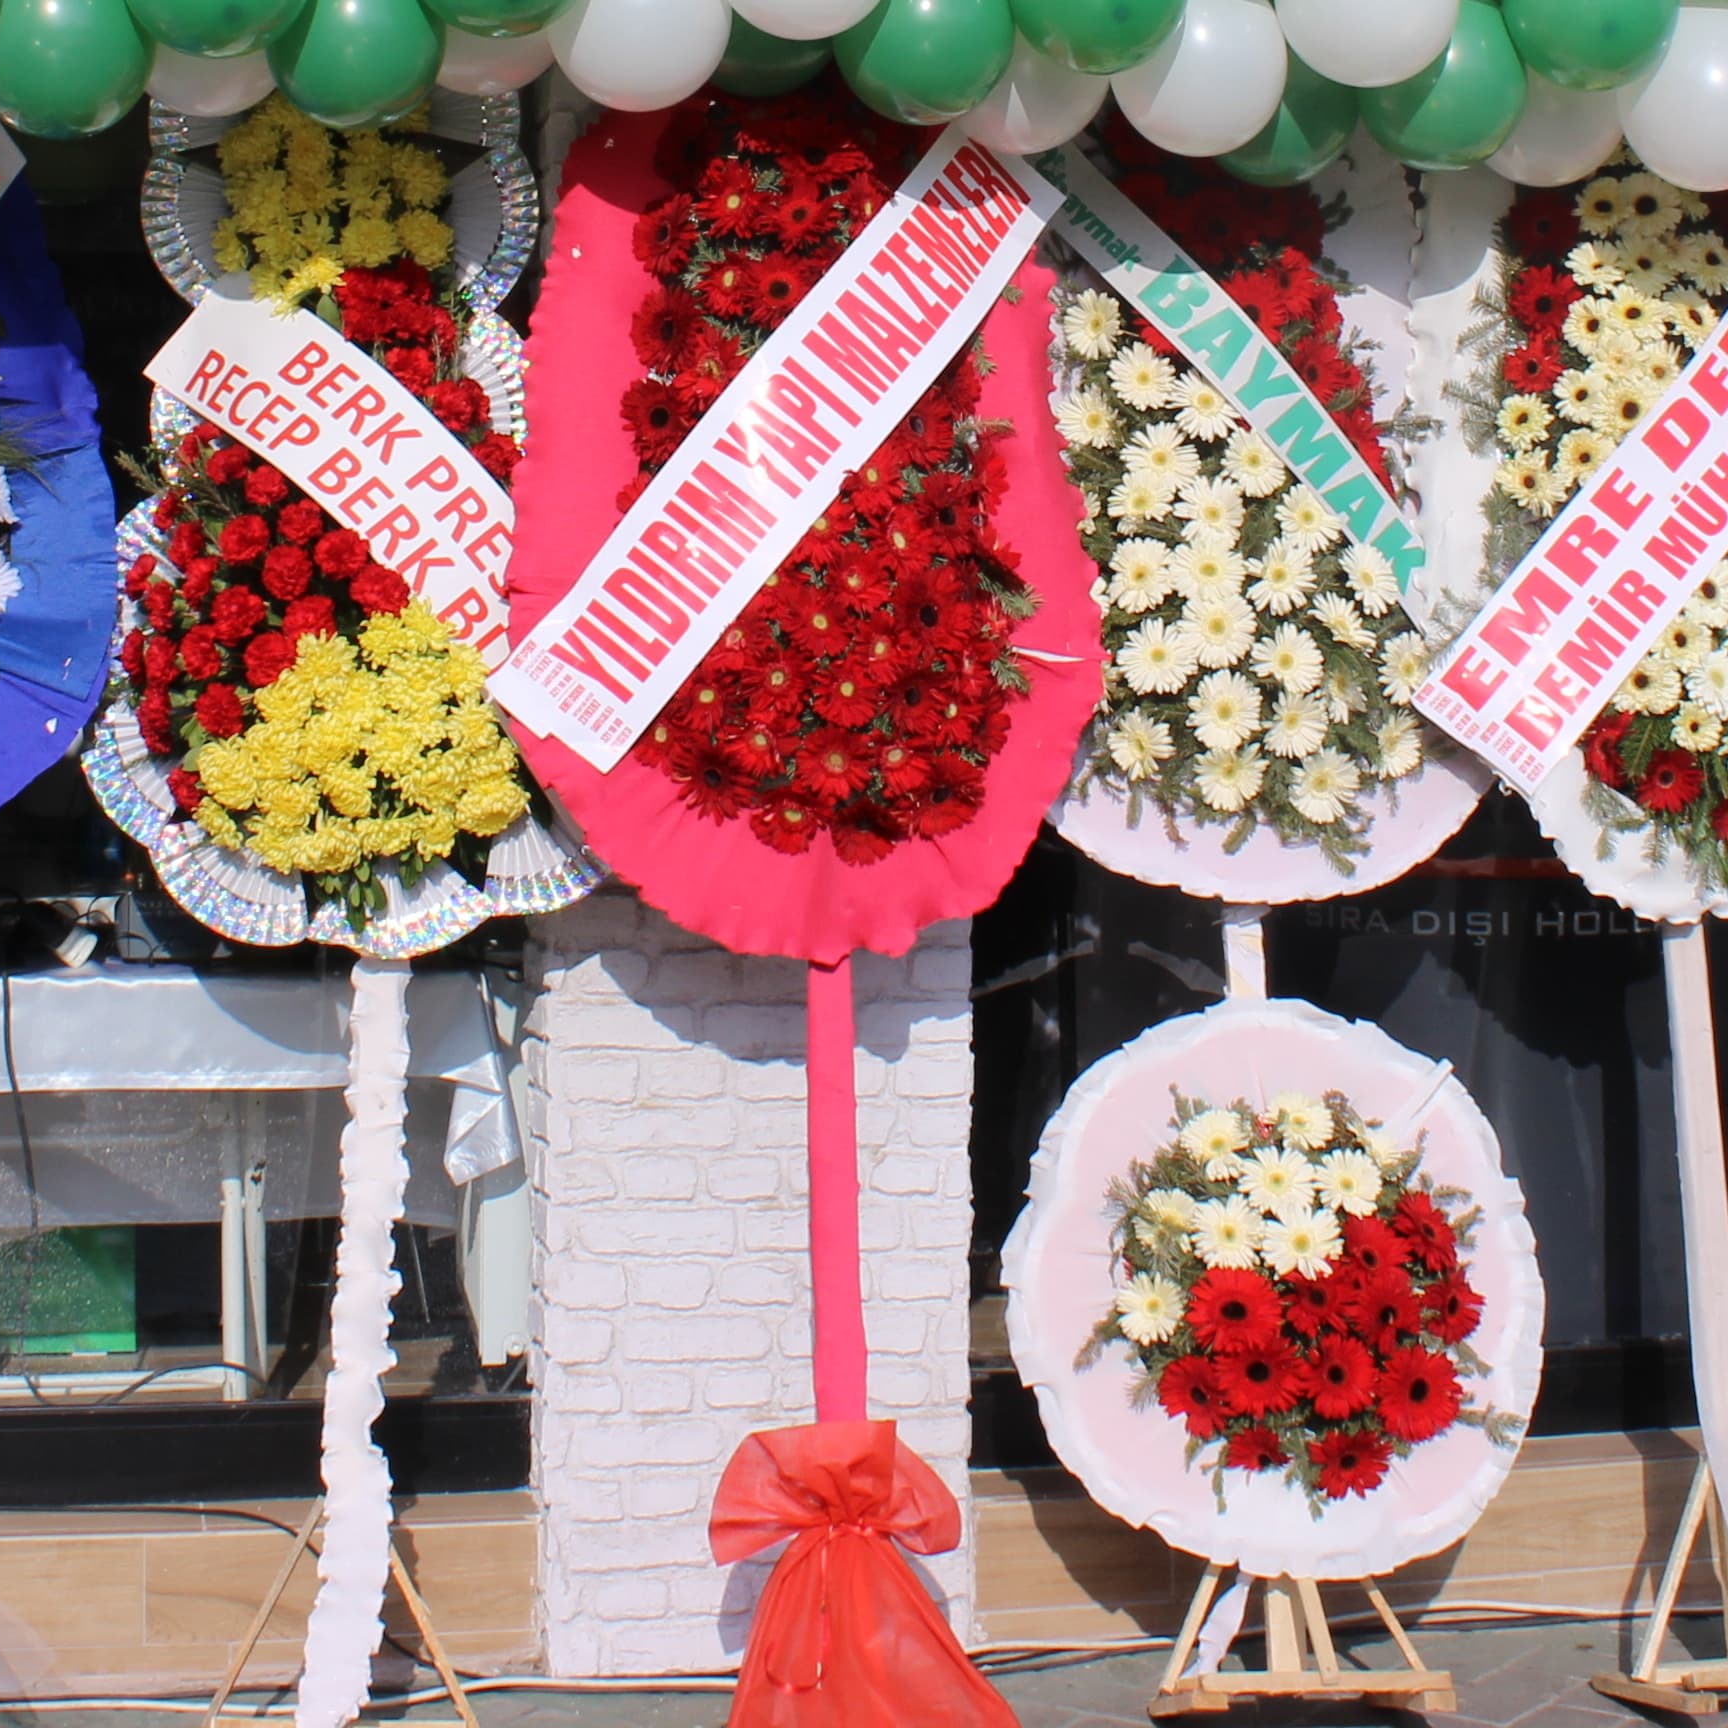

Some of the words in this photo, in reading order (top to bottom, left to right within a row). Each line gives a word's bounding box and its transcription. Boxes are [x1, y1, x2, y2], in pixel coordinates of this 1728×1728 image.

[184, 349, 321, 451] RECEP
[306, 447, 455, 596] BERK
[278, 340, 423, 466] BERK
[1135, 254, 1426, 595] BAYMAK
[549, 458, 778, 704] YILDIRIM
[714, 355, 863, 500] YAPI
[1439, 468, 1654, 712] EMRE
[1503, 569, 1667, 752] DEMİR
[1305, 902, 1390, 935] SIRA
[1412, 910, 1510, 946] DIŞI
